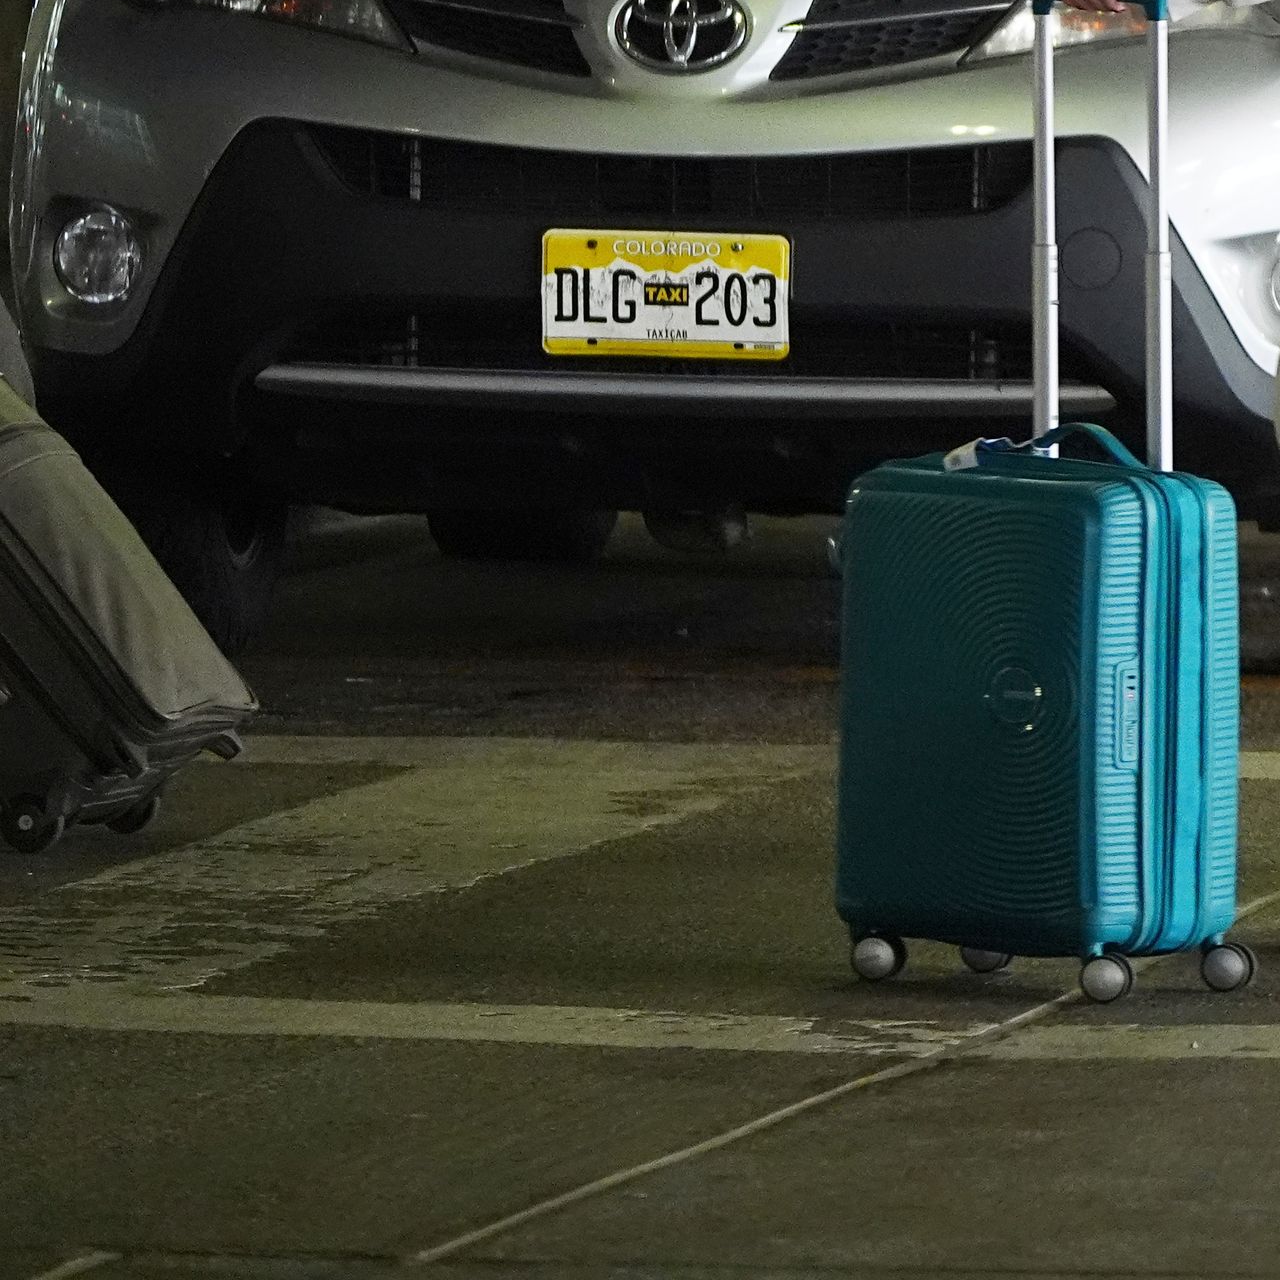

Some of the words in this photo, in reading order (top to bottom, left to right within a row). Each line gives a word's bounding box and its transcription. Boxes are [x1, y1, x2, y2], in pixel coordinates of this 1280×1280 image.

[612, 239, 722, 258] COLORADO
[553, 267, 638, 324] DLG
[645, 285, 689, 304] TAXI
[694, 270, 777, 327] 203
